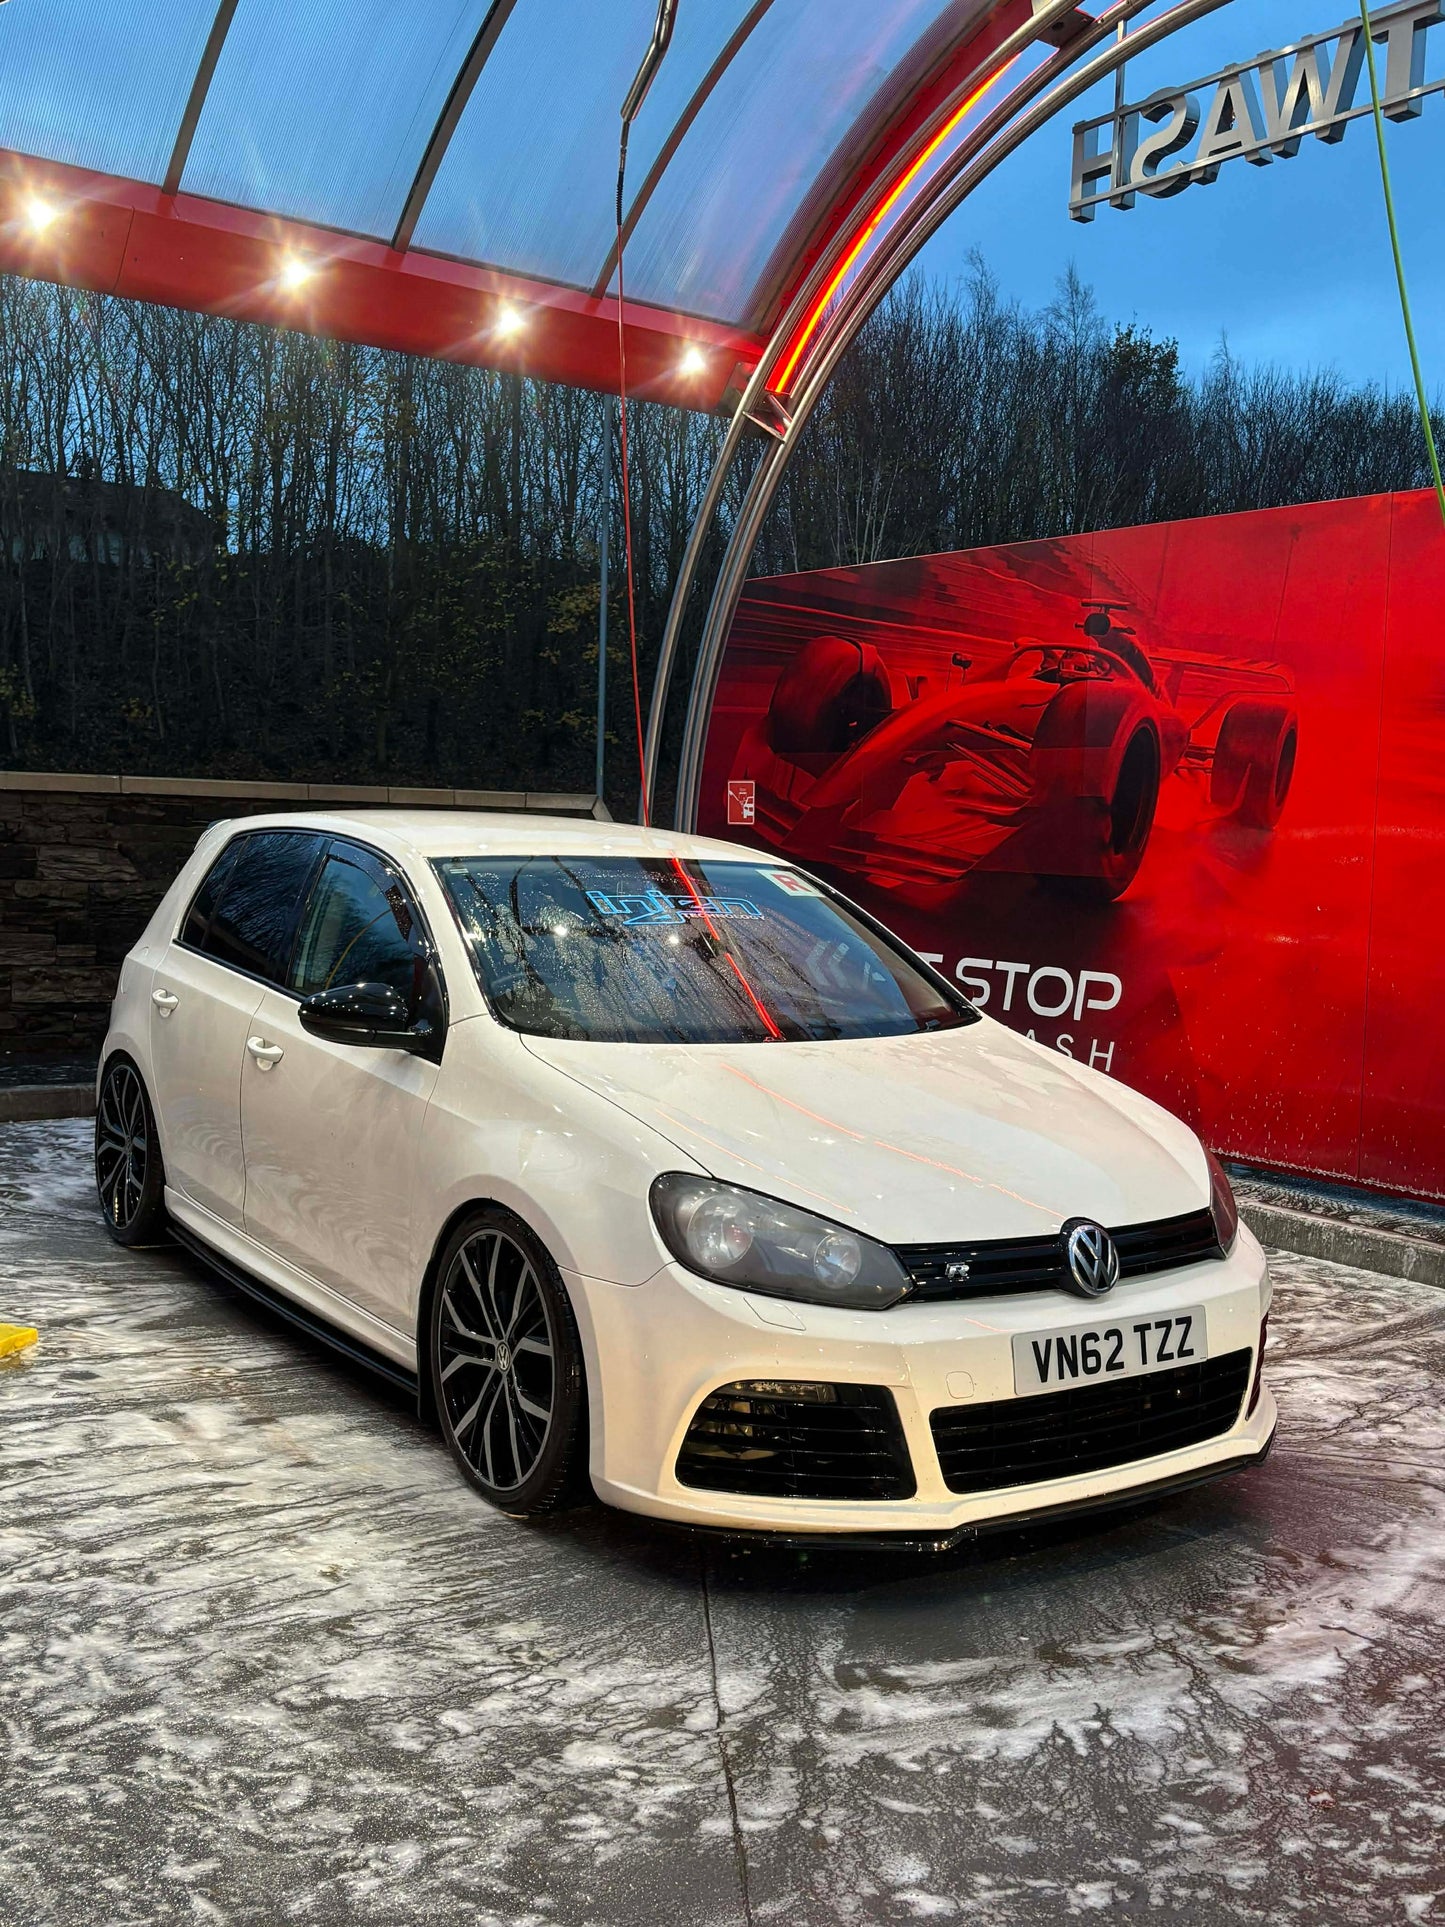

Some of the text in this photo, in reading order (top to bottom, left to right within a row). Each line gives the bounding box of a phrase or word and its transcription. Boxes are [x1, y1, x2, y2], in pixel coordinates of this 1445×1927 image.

[771, 874, 812, 892] R
[955, 957, 1123, 1021] STOP
[1031, 1315, 1195, 1383] VN62 TZZ
